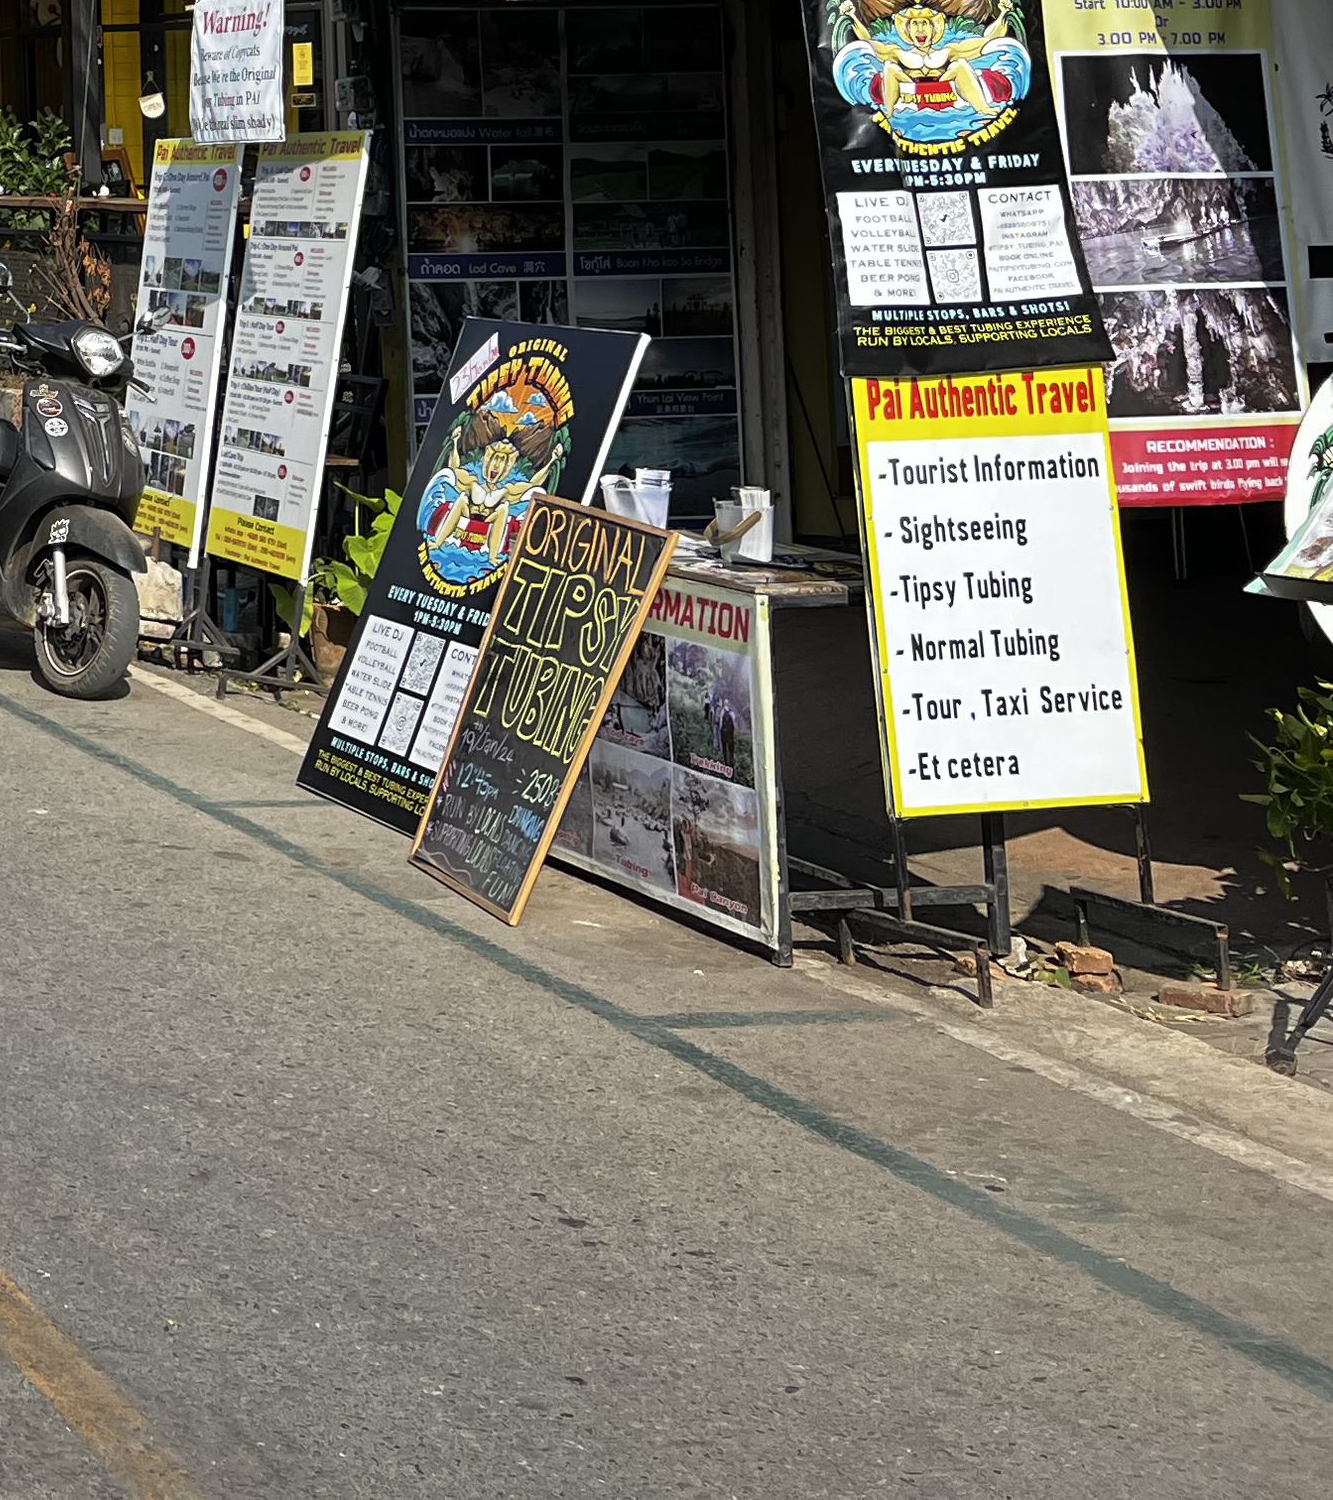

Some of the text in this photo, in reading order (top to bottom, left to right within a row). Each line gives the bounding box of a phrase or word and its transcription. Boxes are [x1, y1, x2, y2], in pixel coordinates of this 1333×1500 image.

[203, 3, 271, 37] Warning!
[1155, 15, 1169, 28] Or
[1097, 32, 1226, 45] 3.00 PM 7.00 PM
[241, 65, 276, 85] Original
[968, 107, 1018, 147] TRAVEL
[280, 138, 327, 157] Authentic
[330, 136, 363, 153] Travel
[987, 153, 1040, 169] FRIDAY
[855, 197, 889, 207] LIVE
[988, 191, 1052, 204] CONTACT
[851, 244, 895, 253] WATER
[469, 263, 487, 274] Lod
[489, 263, 516, 274] Cave
[851, 259, 891, 268] TABLE
[860, 274, 894, 283] BEER
[871, 309, 924, 321] MULTIPLE
[972, 306, 1005, 319] BARS
[1021, 301, 1071, 315] SHOTS!
[853, 314, 1092, 337] THE BIGGEST BEST TUBING EXPERIENCE
[857, 323, 1093, 346] RUN BY SUPPORTING LOCALS
[509, 339, 568, 361] ORIGINAL
[466, 359, 523, 410] TIPSY
[867, 369, 1096, 421] Pai Authentic Travel
[1146, 436, 1266, 453] RECOMMENDATION
[974, 451, 1100, 483] Information
[900, 513, 1028, 550] Sightseeing
[525, 506, 646, 596] ORIGINAL
[964, 571, 1033, 605] Tubing
[504, 557, 641, 671] TIPSY
[911, 629, 1060, 662] Normal Tubing
[473, 635, 605, 764] TUBING
[981, 688, 1029, 717] Taxi
[1040, 684, 1123, 714] Service
[948, 752, 1020, 778] cetera
